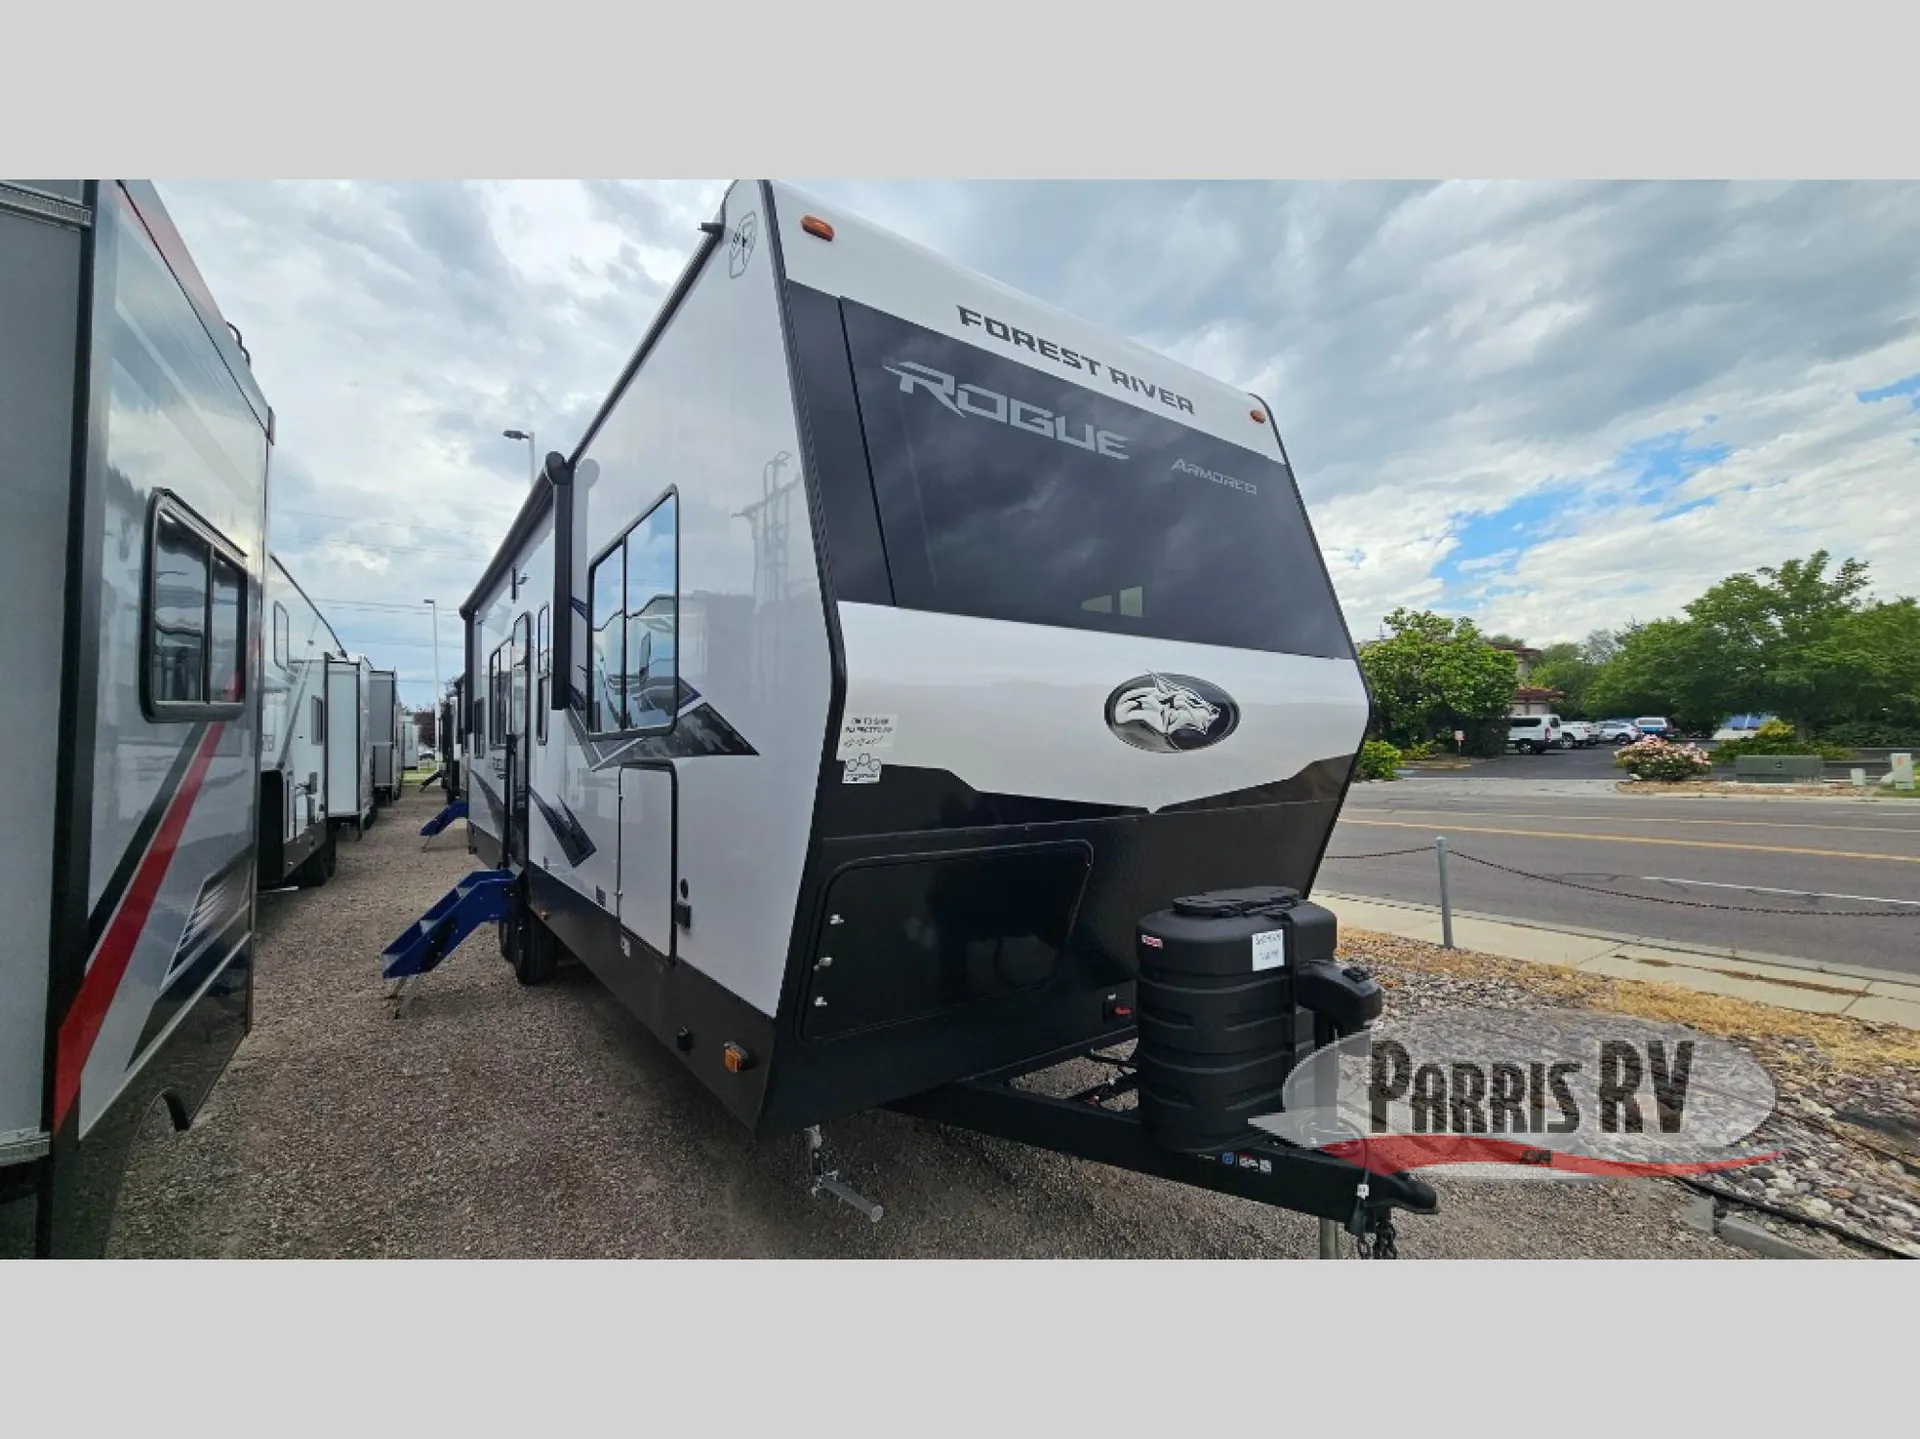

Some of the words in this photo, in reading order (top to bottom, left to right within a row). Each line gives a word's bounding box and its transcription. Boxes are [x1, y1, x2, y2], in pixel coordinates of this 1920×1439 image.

[882, 360, 1130, 460] ROGUE
[956, 304, 1101, 377] FOREST
[1107, 364, 1196, 416] RIVER
[1171, 457, 1257, 495] ARMORED
